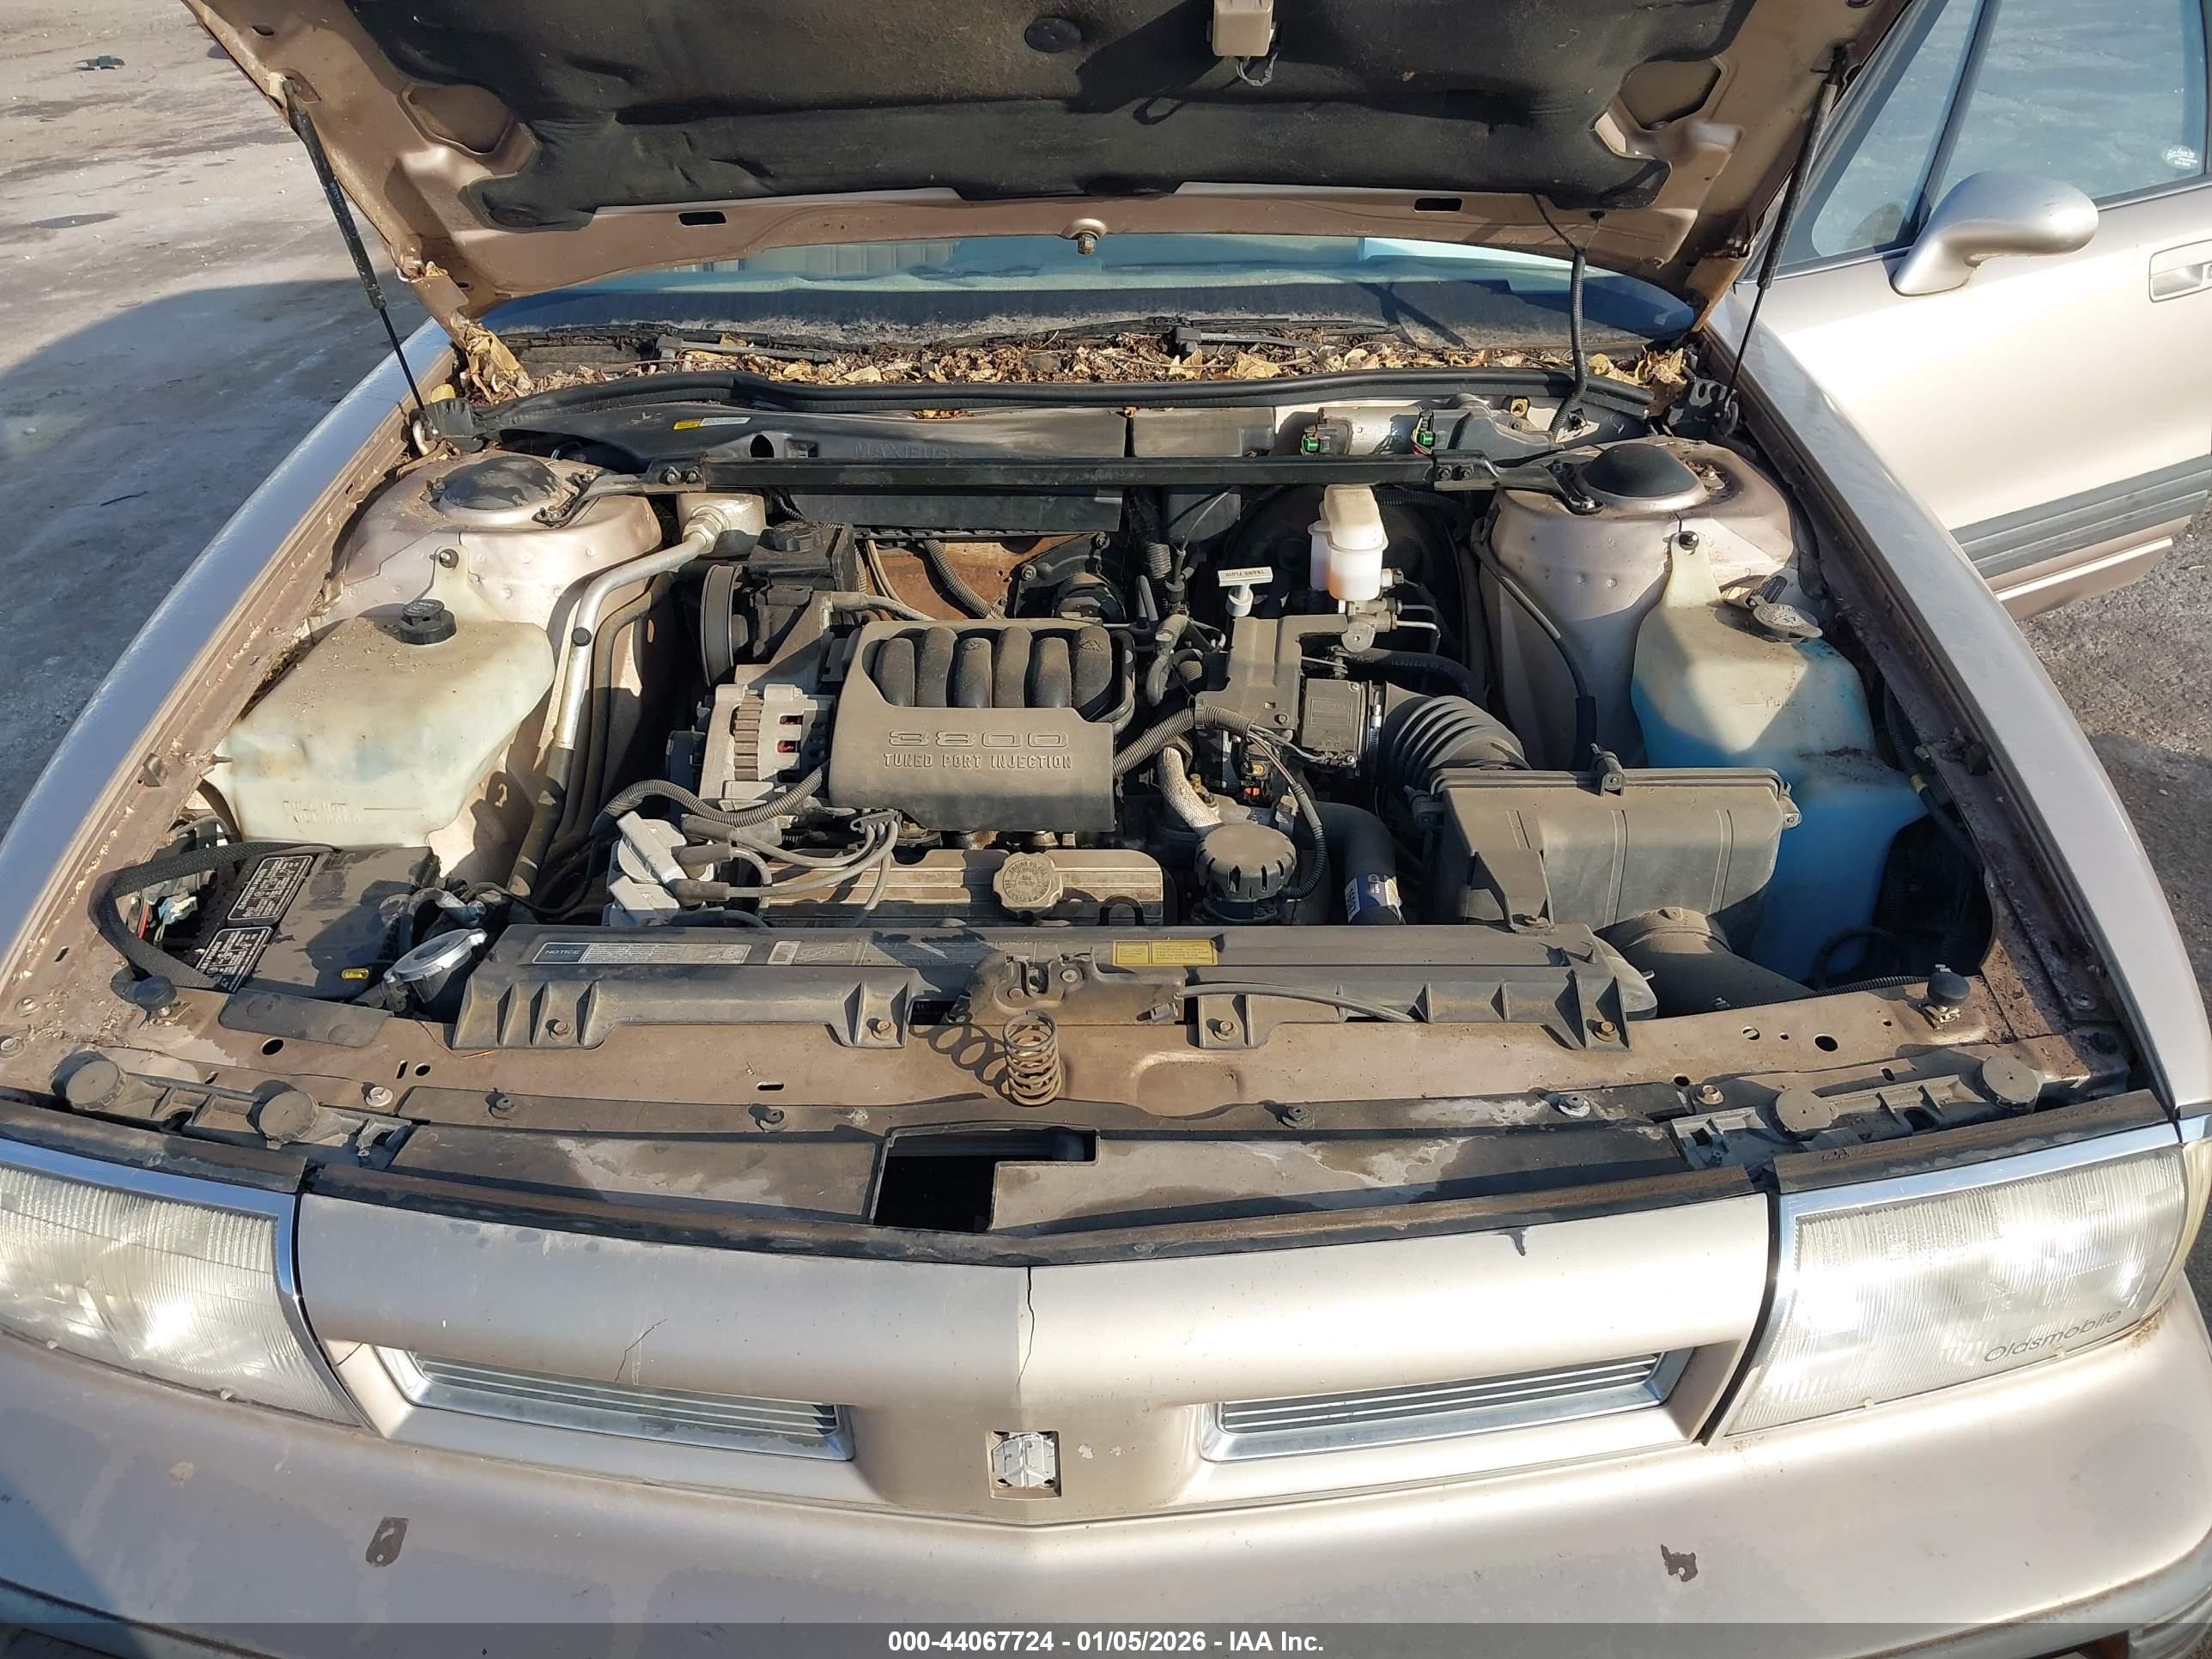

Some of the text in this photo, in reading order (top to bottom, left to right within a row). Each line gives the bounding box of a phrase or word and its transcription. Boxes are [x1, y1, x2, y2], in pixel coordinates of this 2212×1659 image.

[888, 730, 1068, 748] 3800
[883, 752, 1073, 769] TUNED PORT INJECTION
[1984, 1310, 2122, 1362] Oldsmobile
